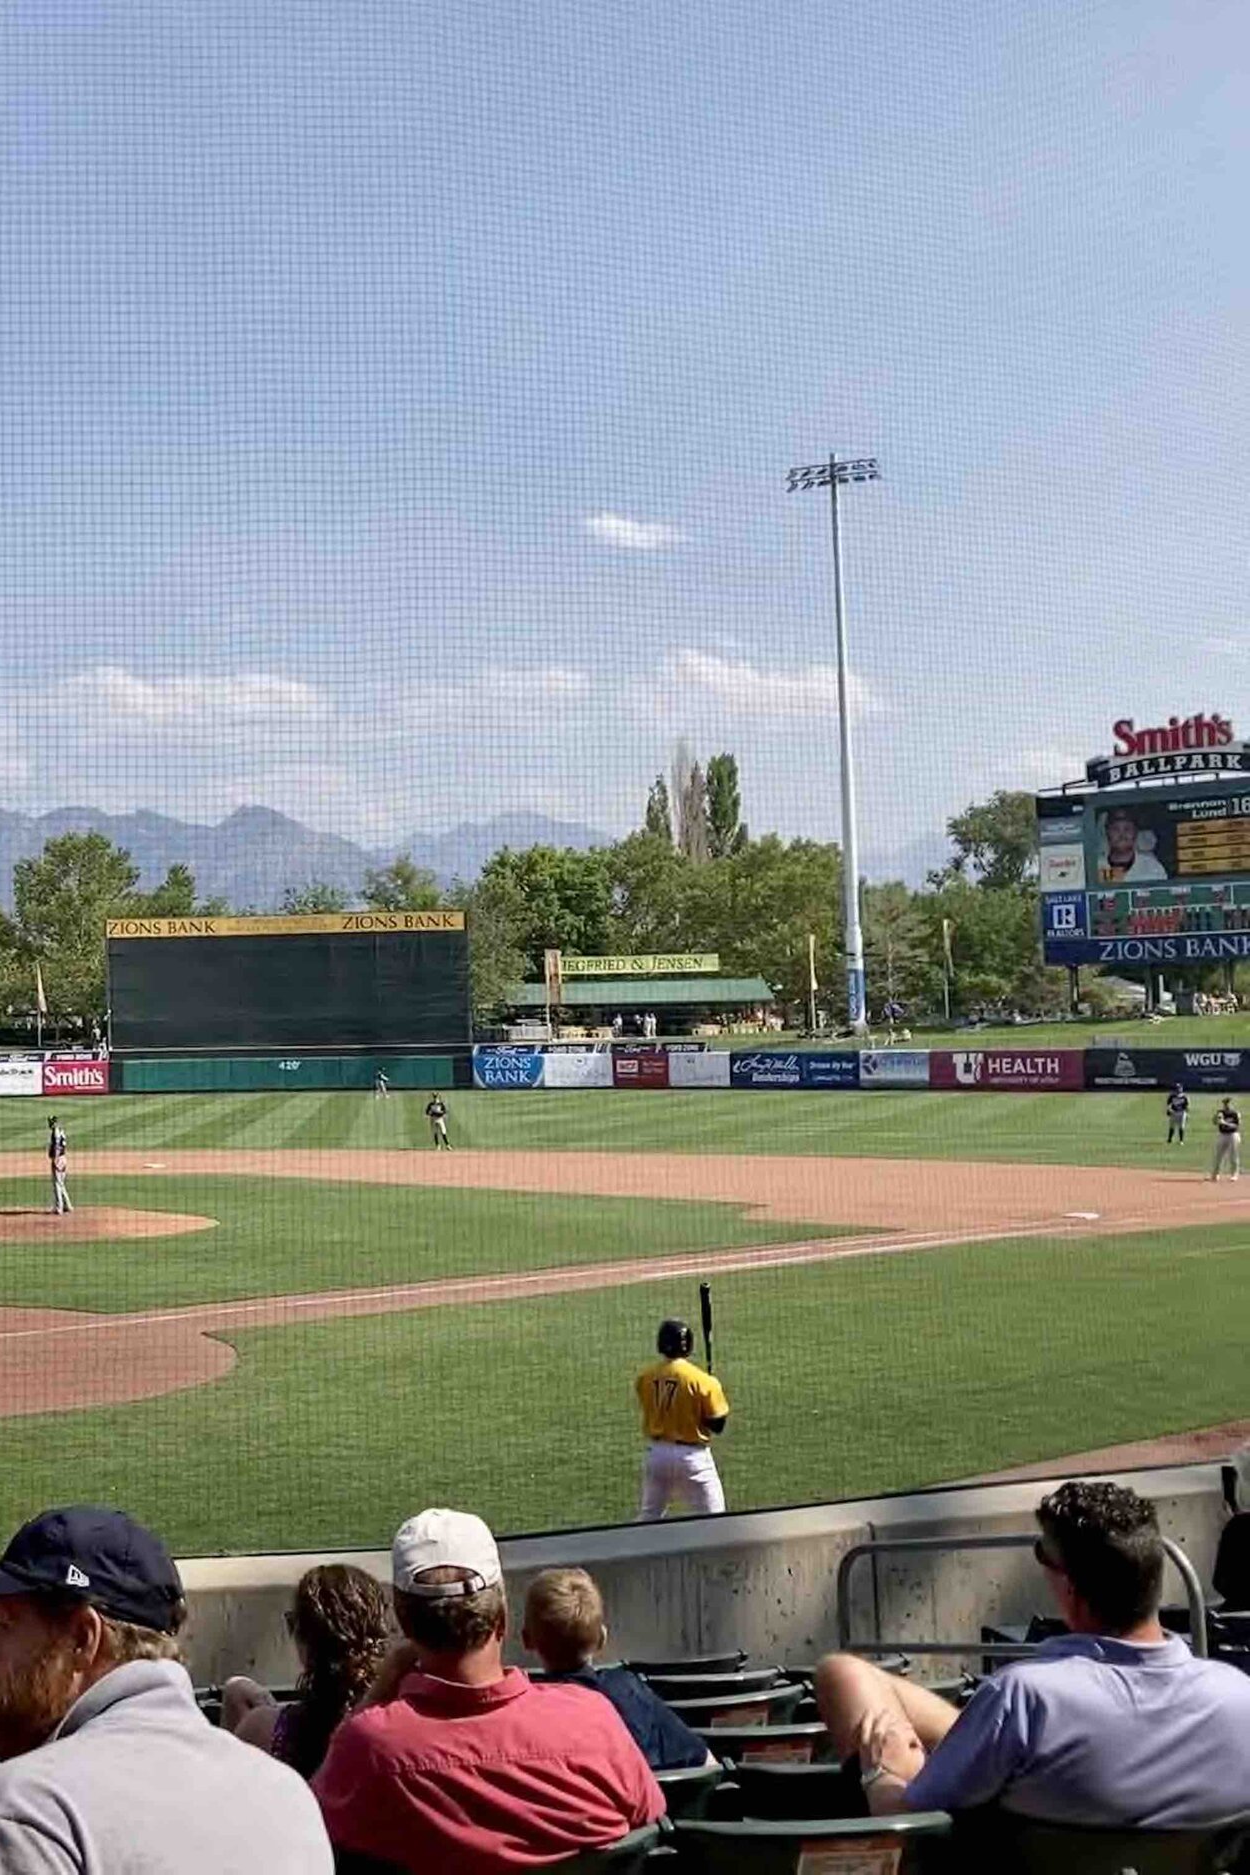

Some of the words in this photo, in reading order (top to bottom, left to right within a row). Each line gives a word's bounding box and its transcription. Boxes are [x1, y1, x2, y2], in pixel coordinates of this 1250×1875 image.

[1113, 713, 1233, 757] Smith's
[1109, 752, 1243, 784] BALLPARK
[1192, 808, 1227, 819] Lund
[108, 920, 162, 936] ZIONS
[167, 919, 217, 935] BANK
[342, 915, 398, 930] ZIONS
[403, 913, 454, 929] BANK
[1100, 938, 1177, 961] ZIONS
[562, 957, 625, 972] IEGFRIED
[630, 958, 643, 971] &
[651, 955, 703, 971] JENSEN
[484, 1057, 531, 1069] ZIONS
[988, 1058, 1059, 1074] HEALTH
[1184, 1053, 1222, 1067] WGU
[44, 1065, 104, 1086] Smith's
[484, 1069, 531, 1083] BANK
[653, 1379, 679, 1412] 17
